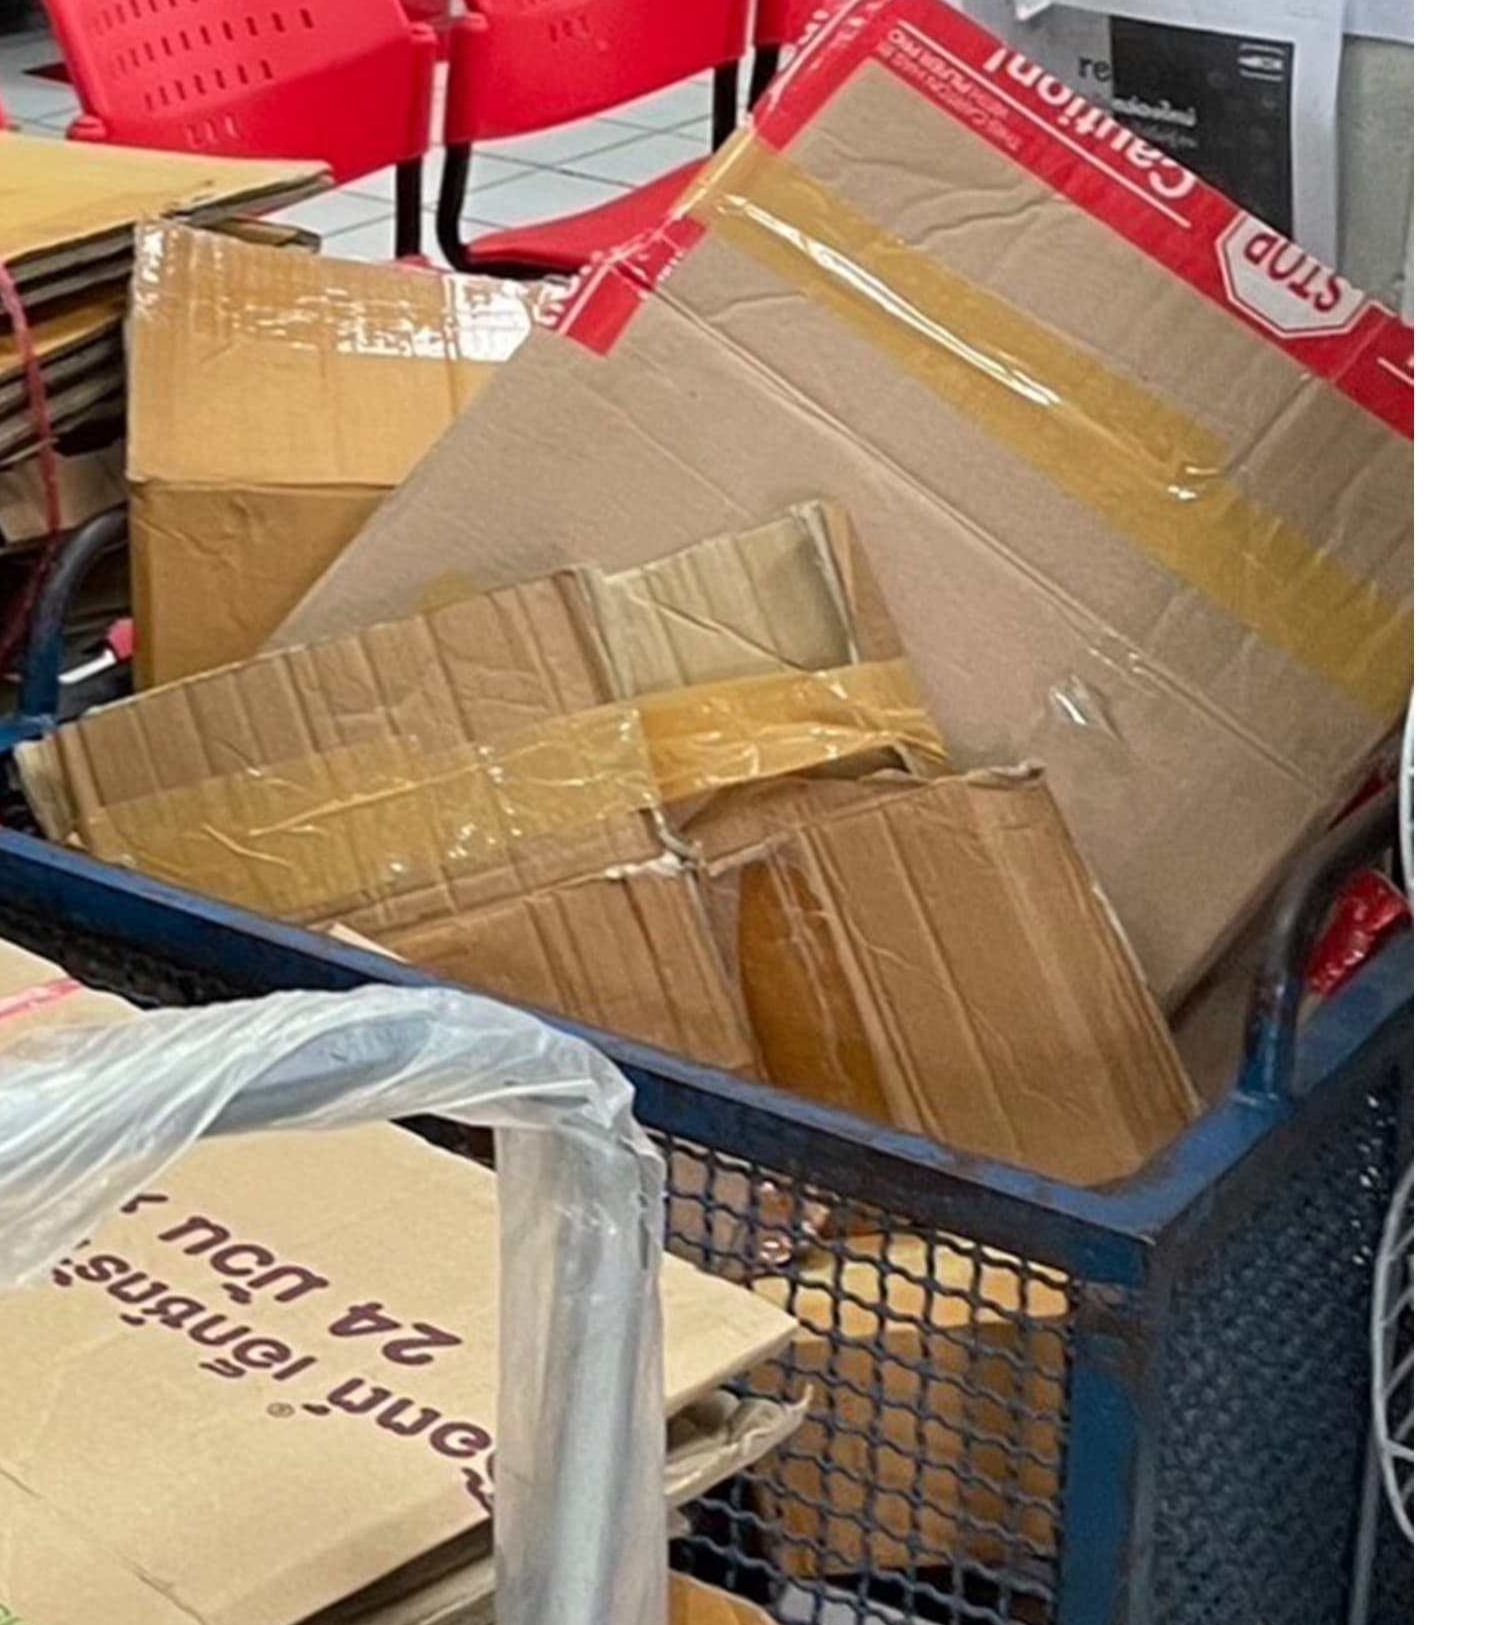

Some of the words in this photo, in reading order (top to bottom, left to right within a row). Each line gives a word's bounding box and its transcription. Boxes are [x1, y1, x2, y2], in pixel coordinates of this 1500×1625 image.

[983, 48, 1198, 200] Caution!
[1242, 232, 1344, 313] STOP
[157, 1216, 330, 1306] ม้วน
[54, 1242, 317, 1380] เอ็กซ์ตร้
[329, 1301, 462, 1369] 24
